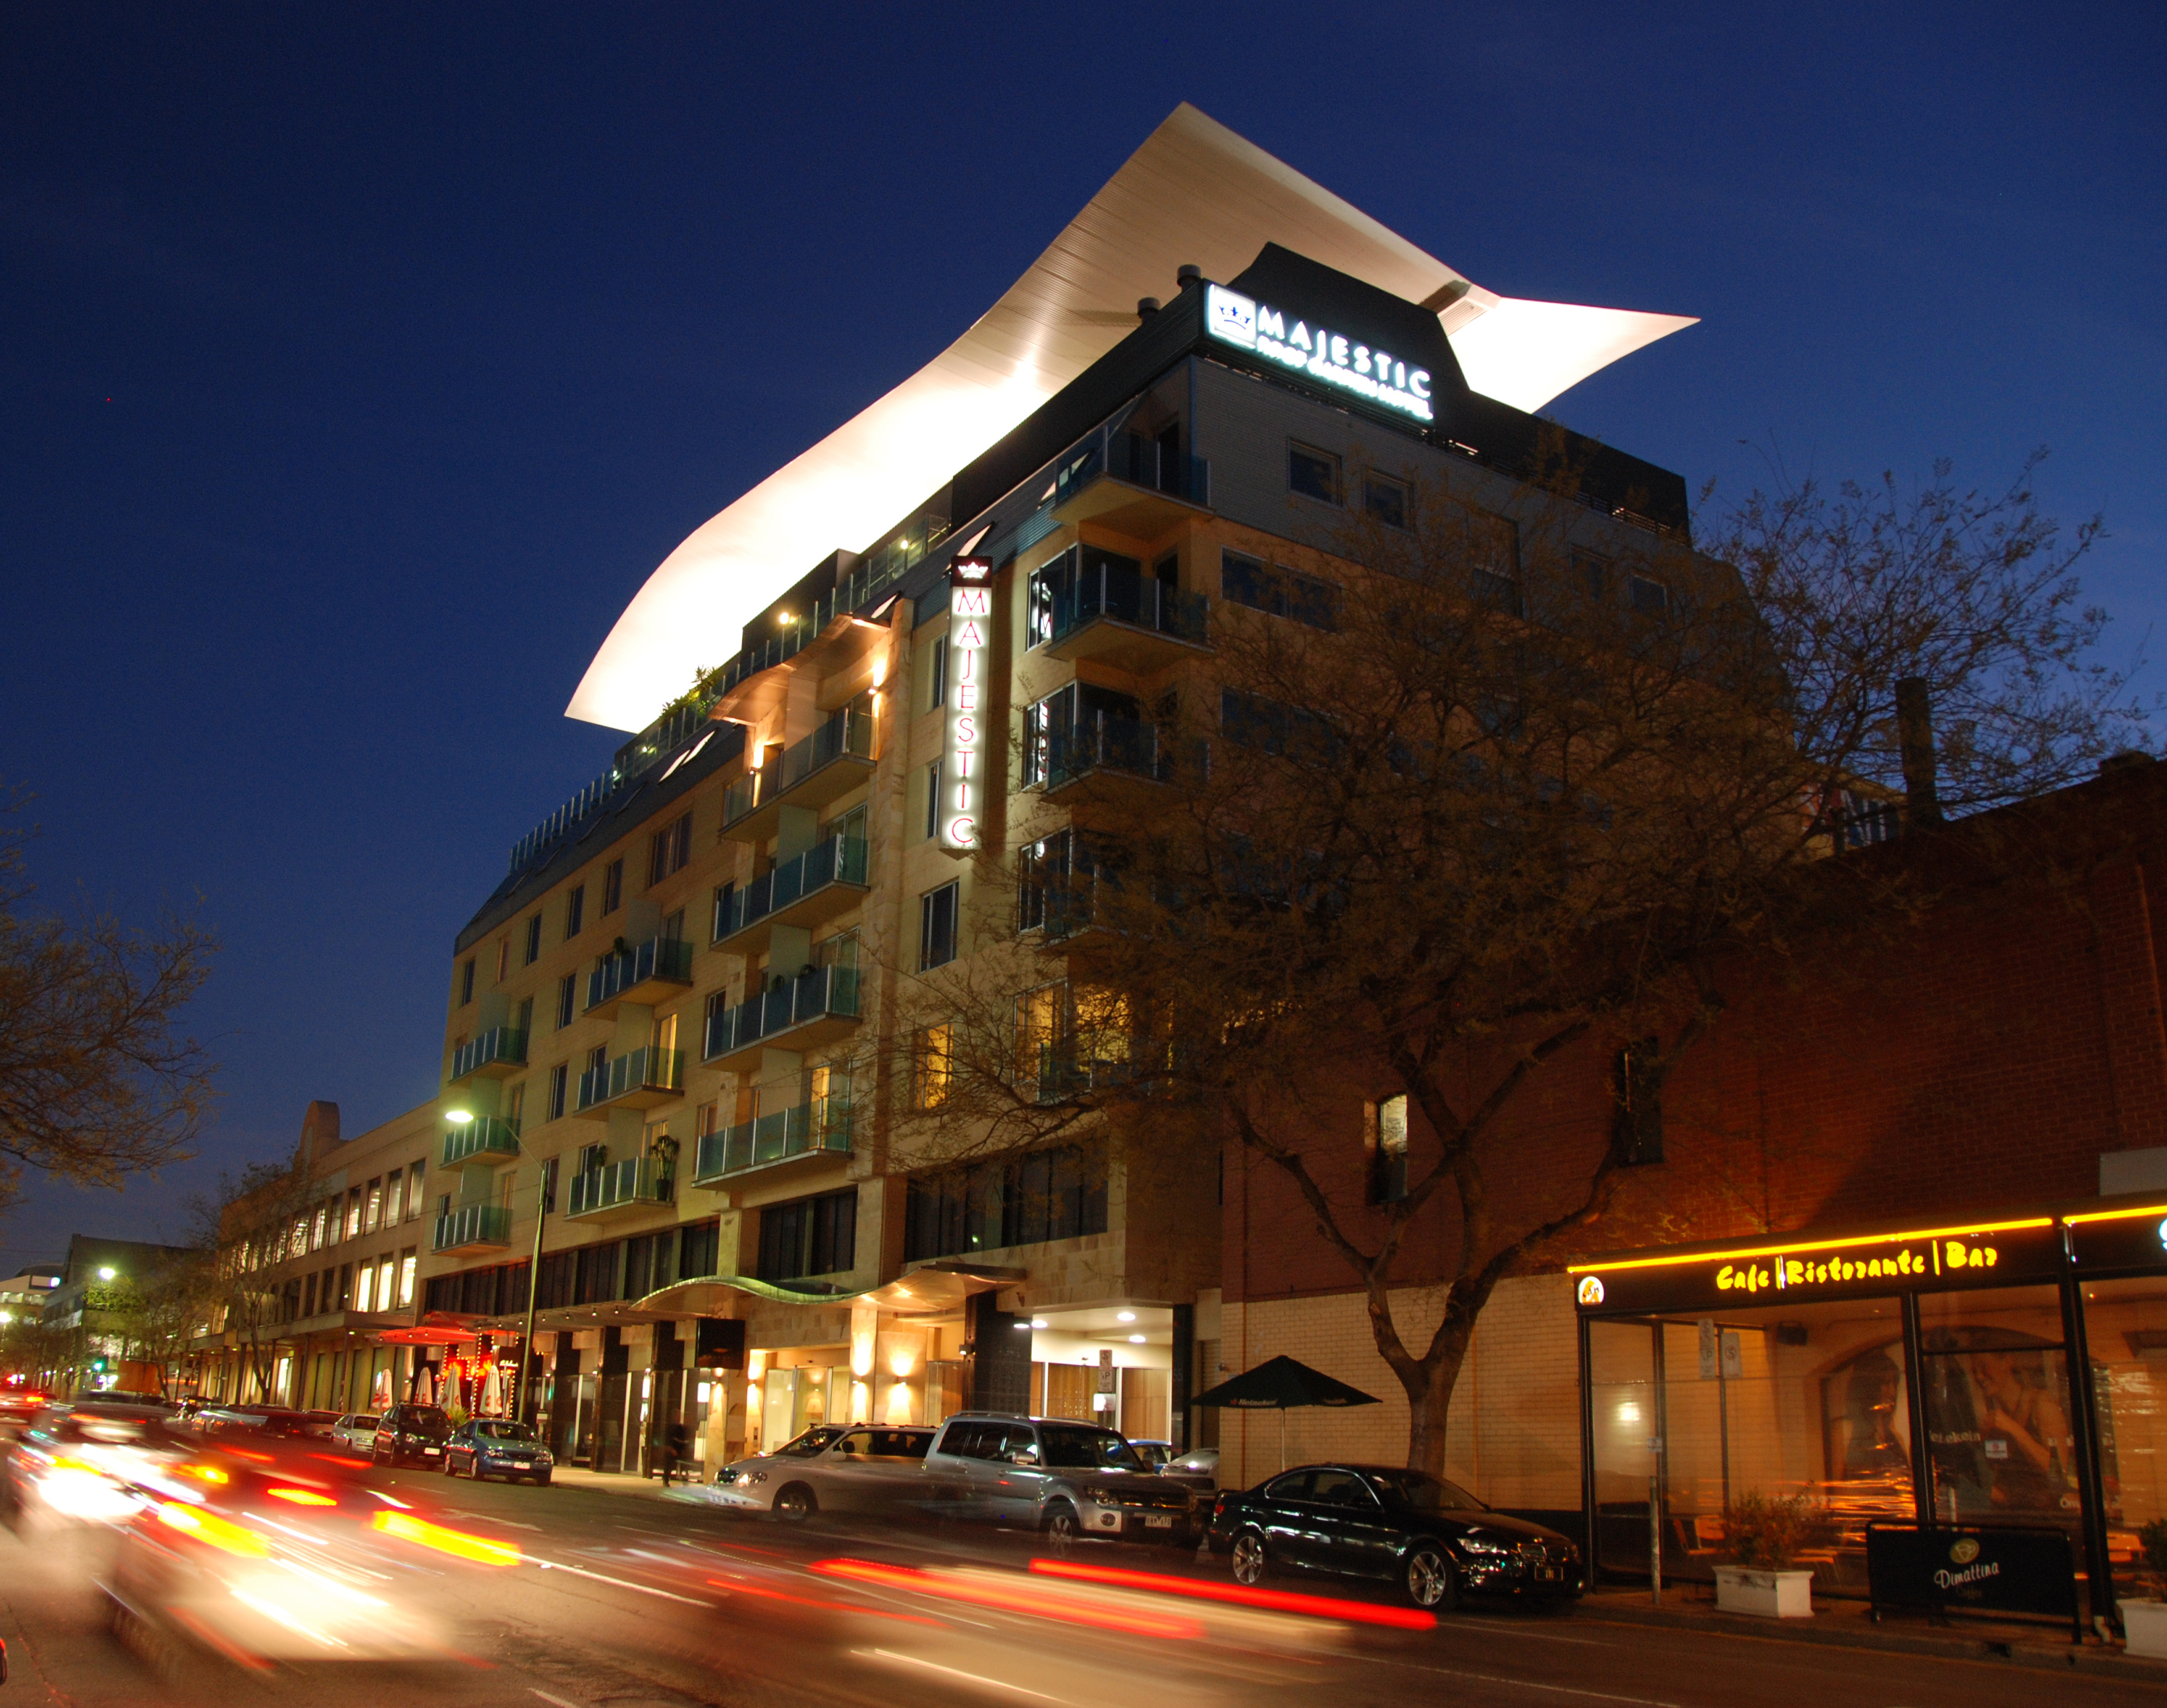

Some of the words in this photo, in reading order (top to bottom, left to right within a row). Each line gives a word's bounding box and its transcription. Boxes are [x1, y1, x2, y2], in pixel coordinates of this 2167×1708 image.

[1258, 304, 1431, 398] MAJESTIC
[951, 588, 986, 843] MAJESTIC
[1786, 1249, 1925, 1285] Ristorante
[1946, 1241, 1997, 1268] Bar
[1934, 1562, 2000, 1589] Dimattina
